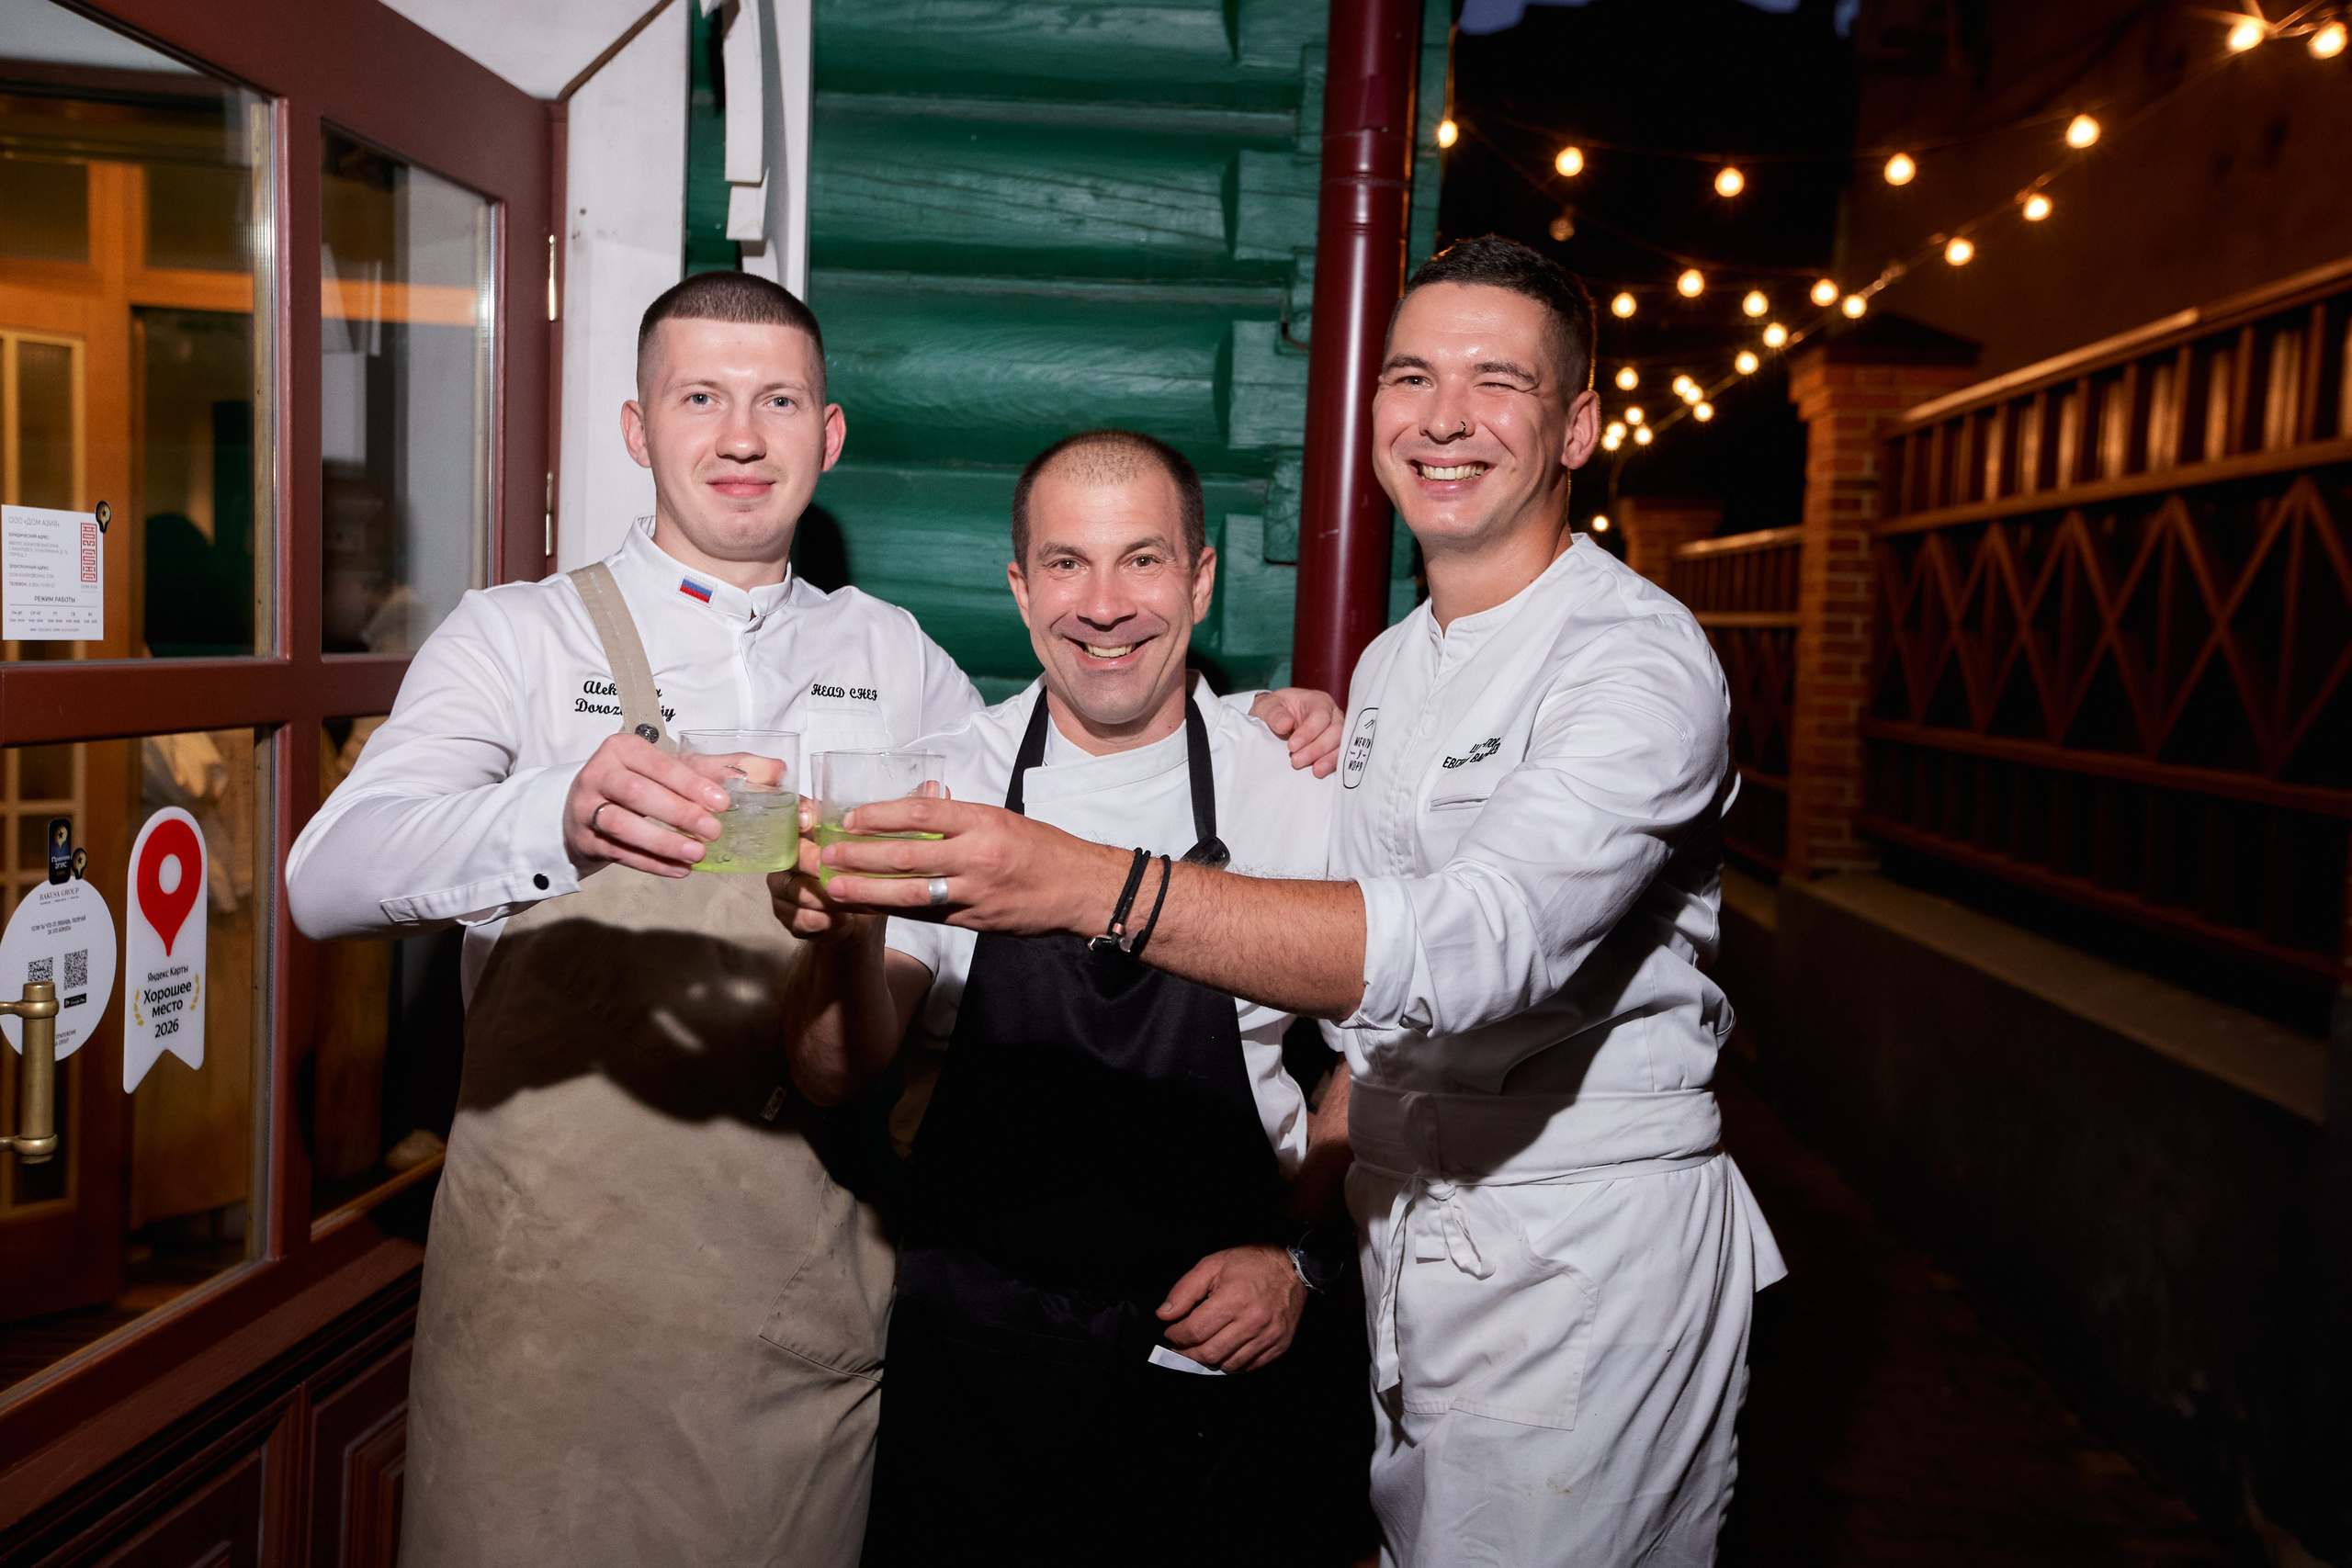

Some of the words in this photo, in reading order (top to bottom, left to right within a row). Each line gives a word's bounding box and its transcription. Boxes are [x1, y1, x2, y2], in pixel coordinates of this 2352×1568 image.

[8, 516, 23, 525] ООО
[811, 683, 845, 698] HEAD
[850, 688, 877, 701] CHEF
[61, 887, 80, 897] GROUP
[147, 970, 169, 983] Яндекс
[169, 965, 189, 976] Карты
[143, 981, 192, 1005] Хорошее
[152, 999, 184, 1018] место
[154, 1018, 179, 1039] 2026
